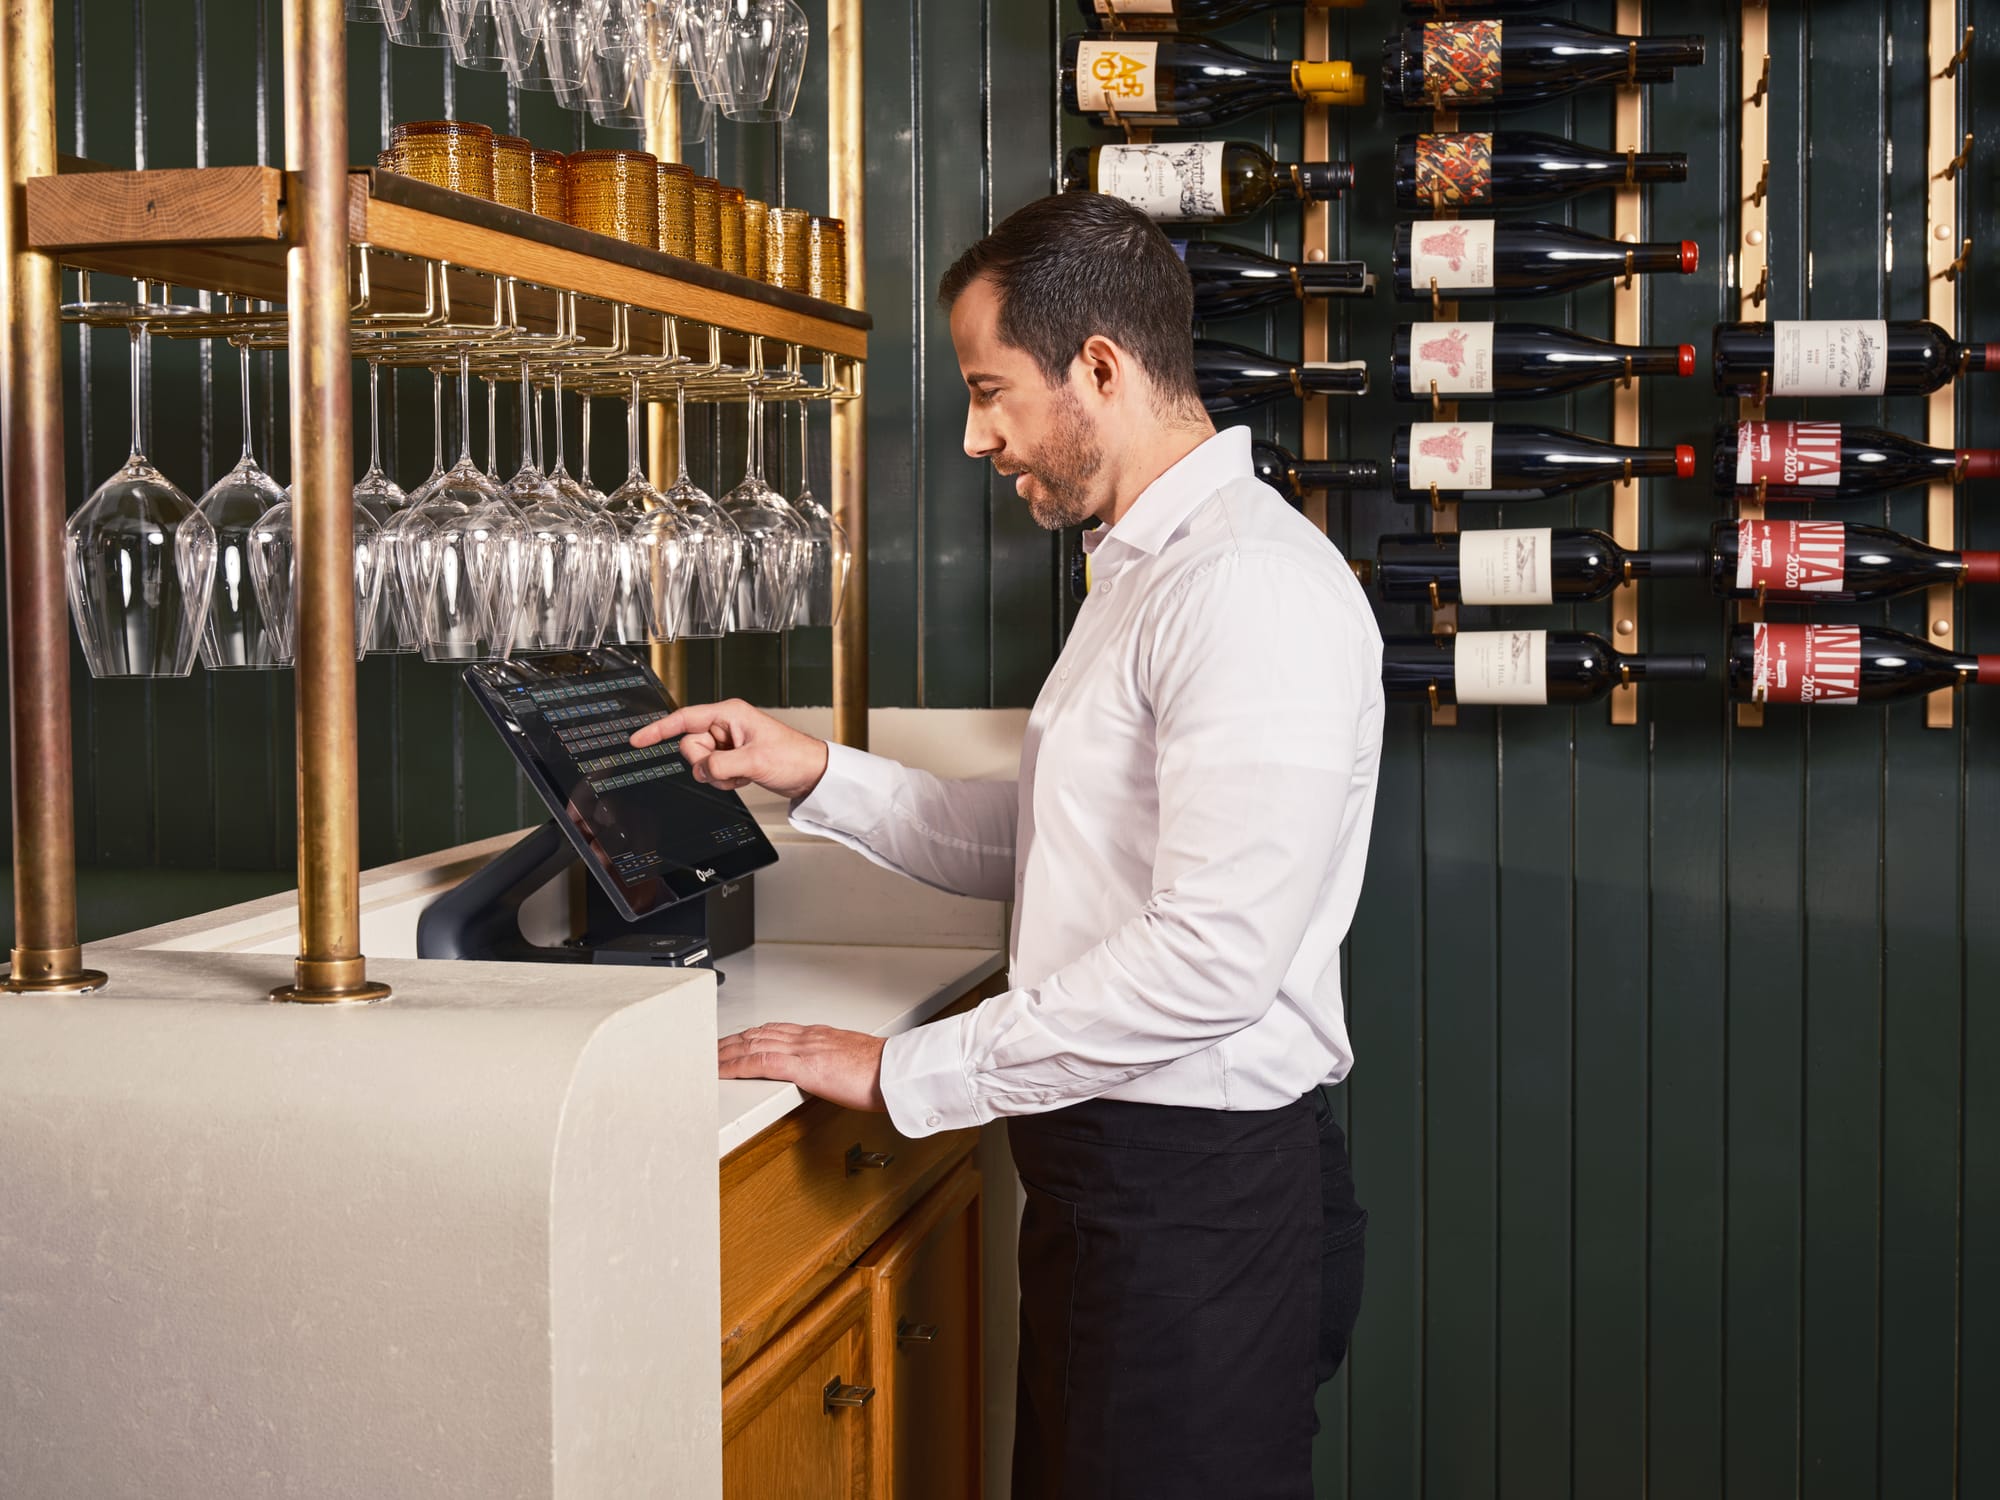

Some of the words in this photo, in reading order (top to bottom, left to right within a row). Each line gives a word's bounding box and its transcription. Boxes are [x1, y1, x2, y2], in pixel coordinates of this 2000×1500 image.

[1784, 448, 1797, 482] 2020
[1785, 553, 1799, 588] 2020
[1800, 675, 1815, 703] 2020
